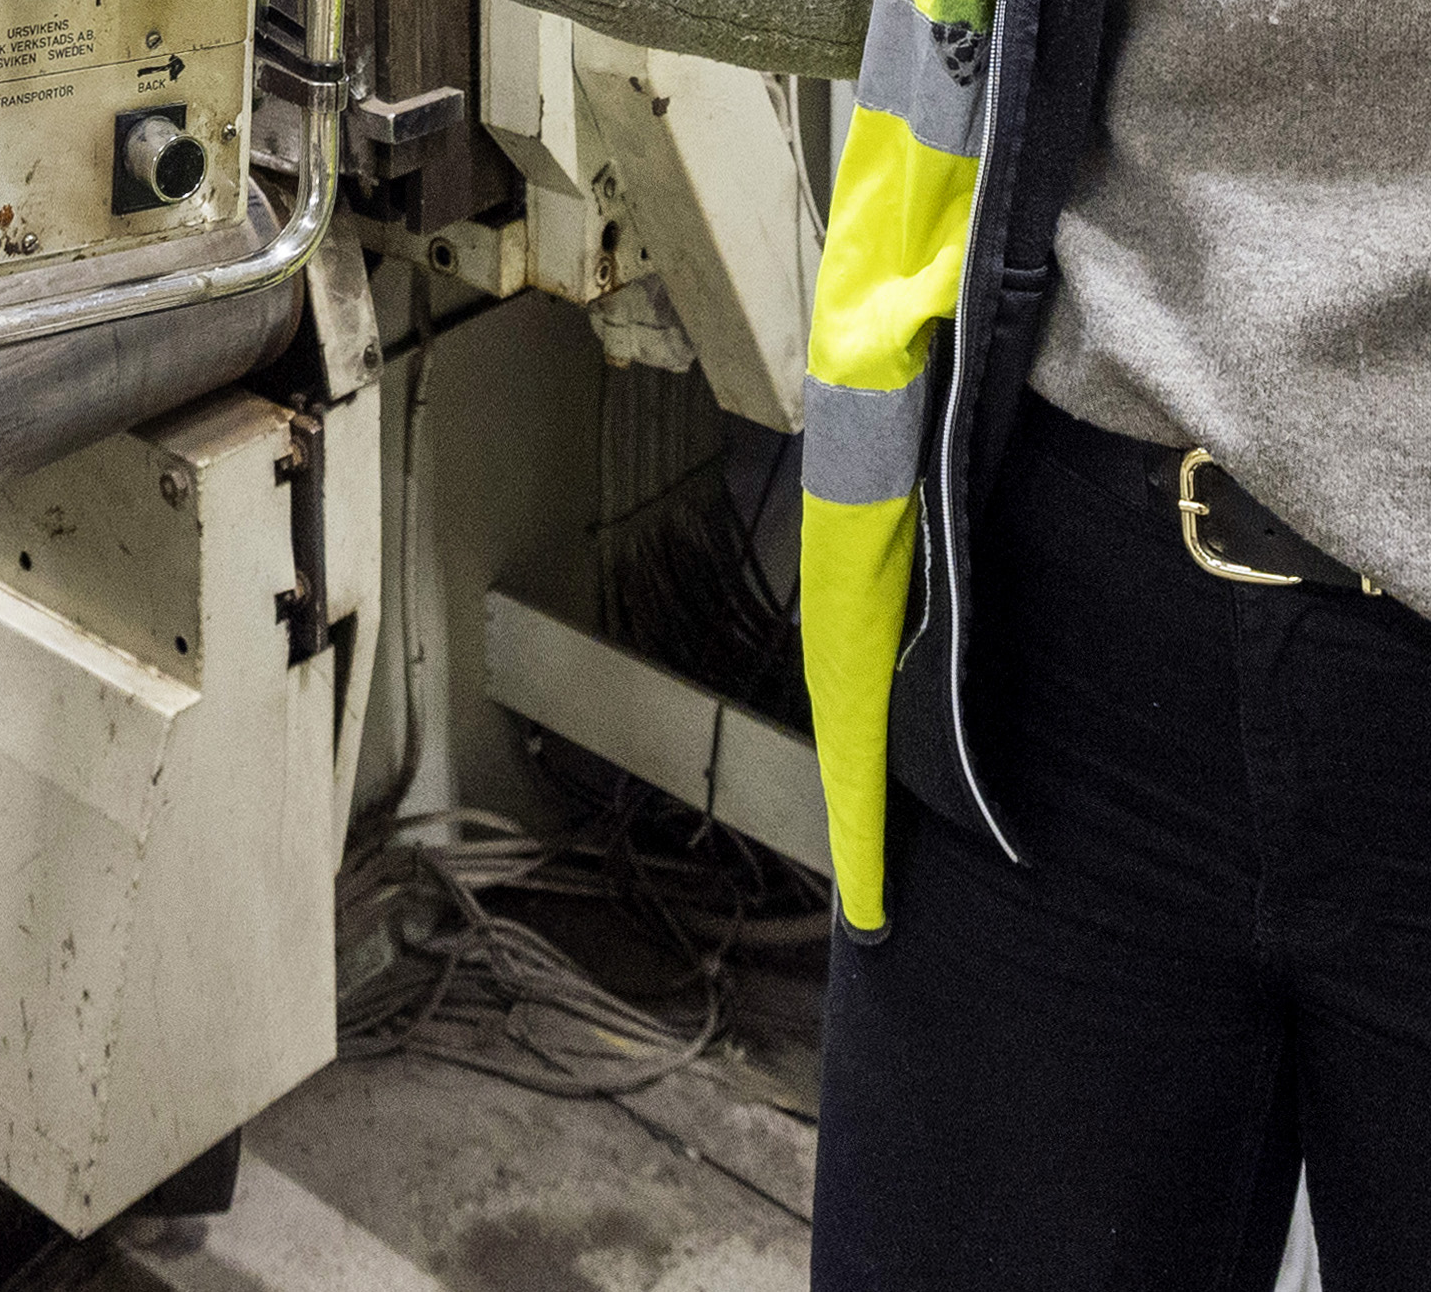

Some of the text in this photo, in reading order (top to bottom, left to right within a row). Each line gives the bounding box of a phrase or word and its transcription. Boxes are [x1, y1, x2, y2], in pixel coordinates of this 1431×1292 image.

[6, 19, 69, 40] URSVIKENS
[10, 34, 74, 54] VERKSTADS
[47, 42, 94, 61] SWEDEN
[138, 79, 166, 93] BACK
